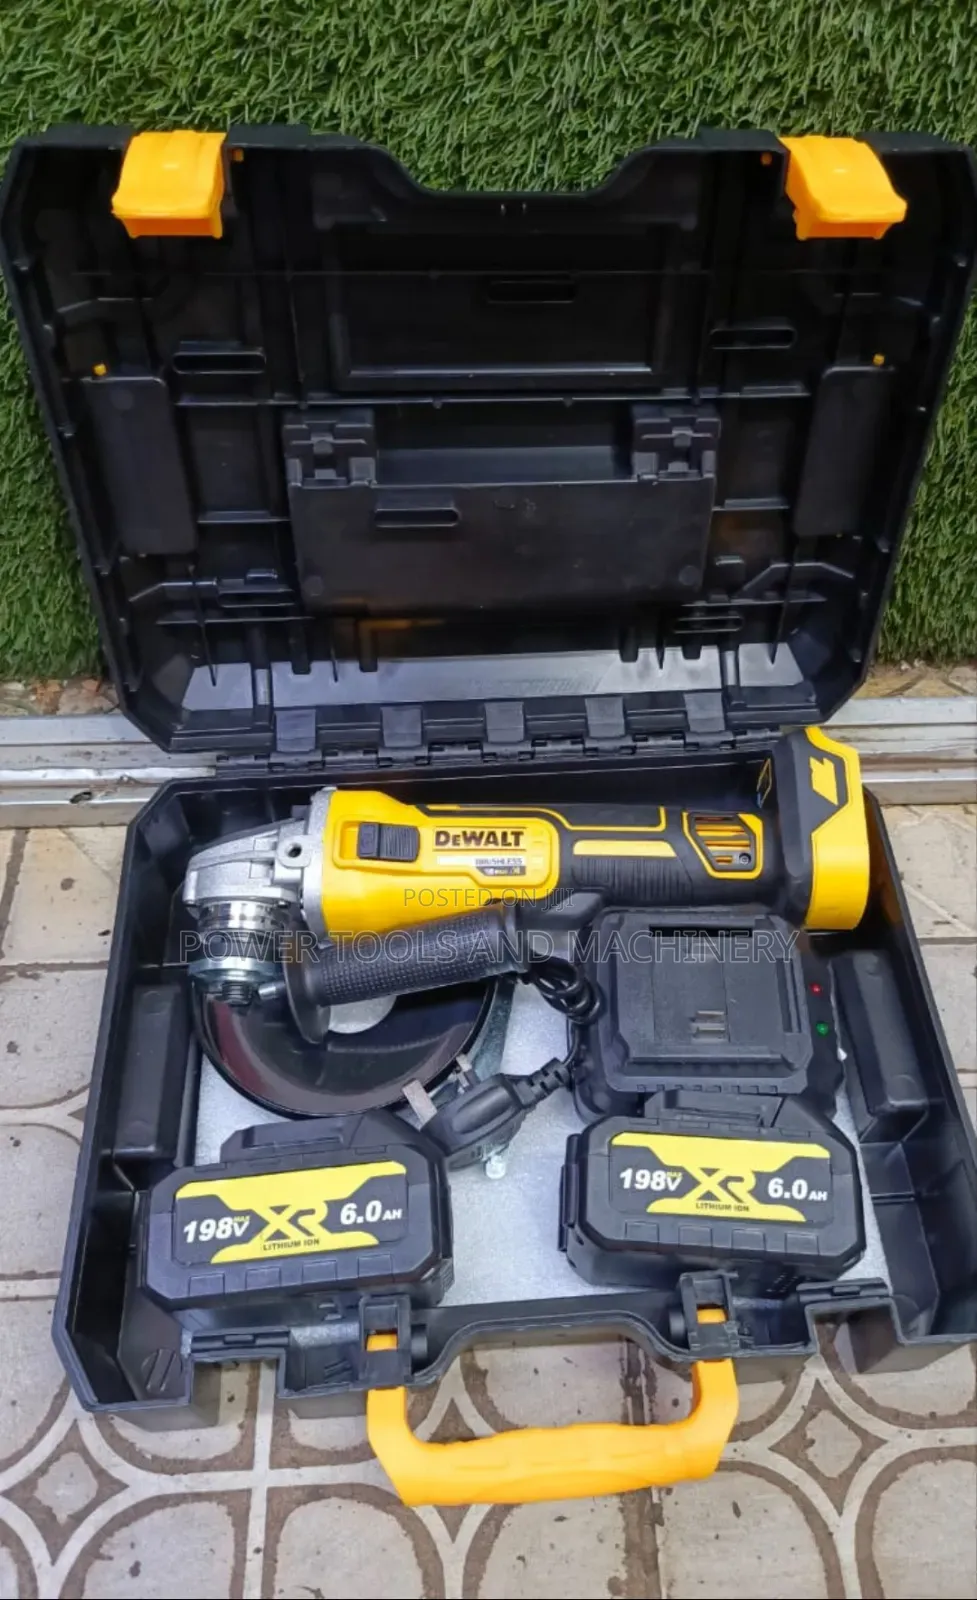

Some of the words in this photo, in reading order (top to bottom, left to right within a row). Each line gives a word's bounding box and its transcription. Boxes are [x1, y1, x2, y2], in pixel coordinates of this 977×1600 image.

[684, 1166, 763, 1204] XR
[695, 1202, 732, 1212] LITHIUM
[734, 1204, 750, 1212] ION
[250, 1200, 332, 1242] XR
[263, 1239, 301, 1251] LITHIUM
[303, 1237, 321, 1248] ION
